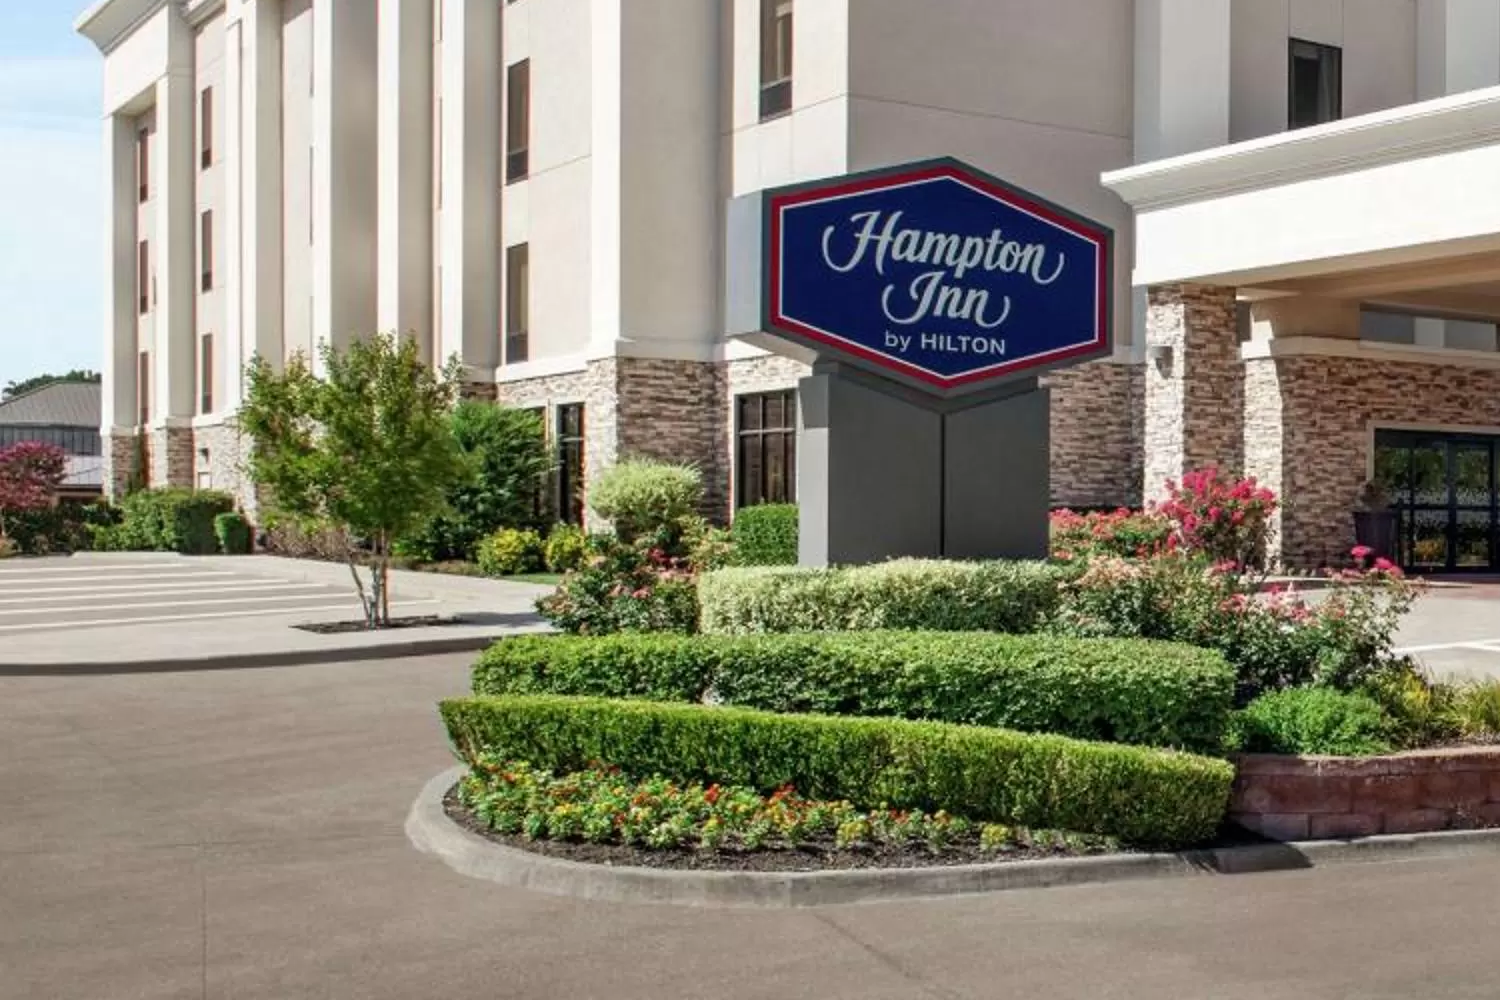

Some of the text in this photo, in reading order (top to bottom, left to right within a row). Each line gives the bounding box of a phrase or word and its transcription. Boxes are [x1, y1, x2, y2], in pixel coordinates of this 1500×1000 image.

[822, 210, 1065, 285] Hampton
[881, 270, 1011, 328] Inn
[885, 330, 1006, 355] by HILTON
